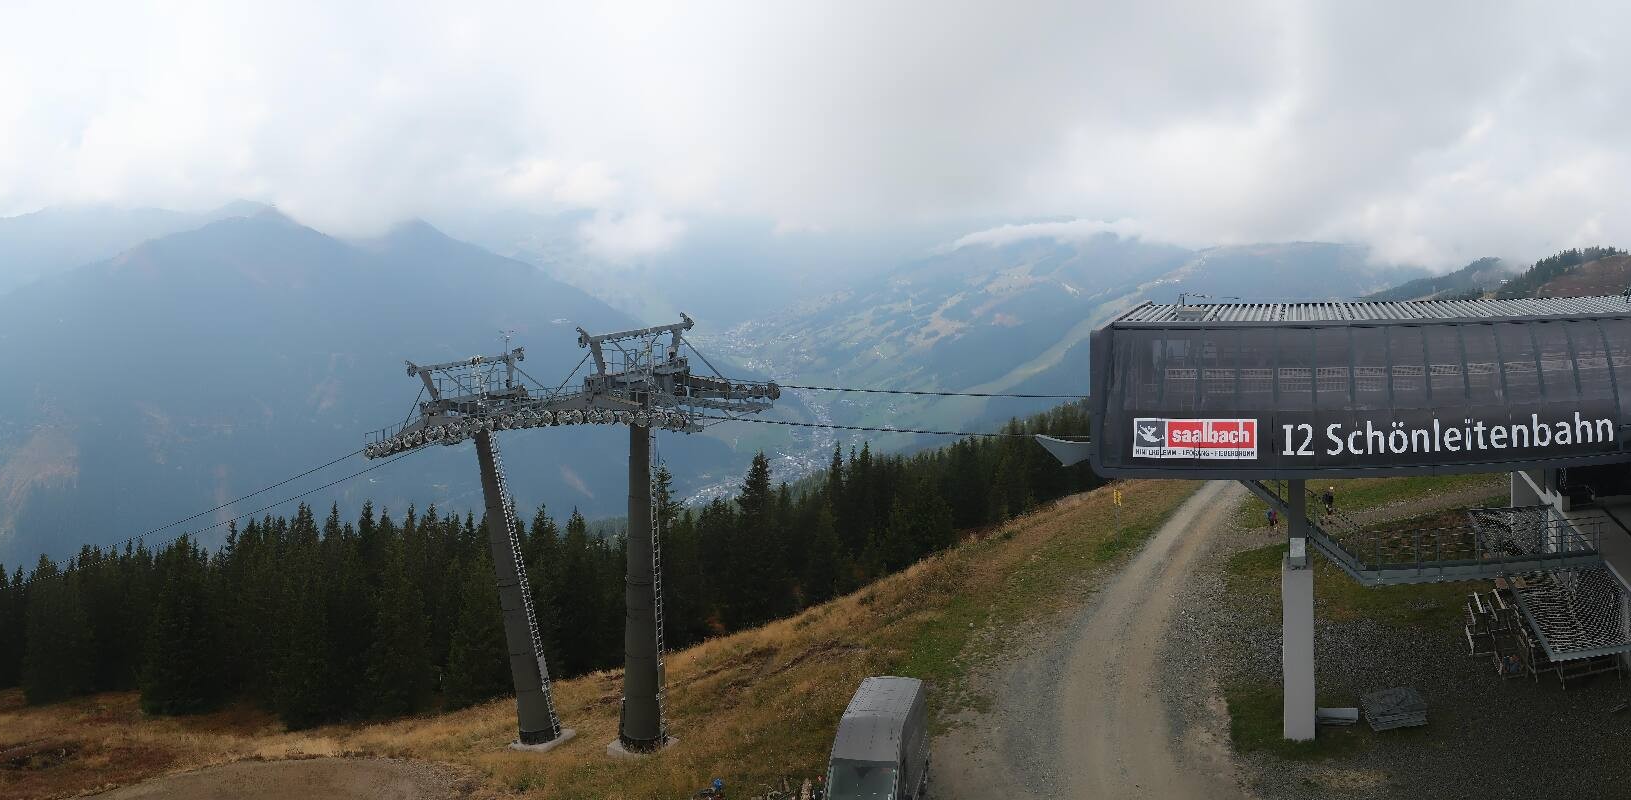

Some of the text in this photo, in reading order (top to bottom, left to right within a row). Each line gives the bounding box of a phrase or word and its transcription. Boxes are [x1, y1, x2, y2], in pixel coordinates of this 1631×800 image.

[1171, 421, 1250, 444] saalbach
[1282, 411, 1614, 456] I2 Schönleitenbahn
